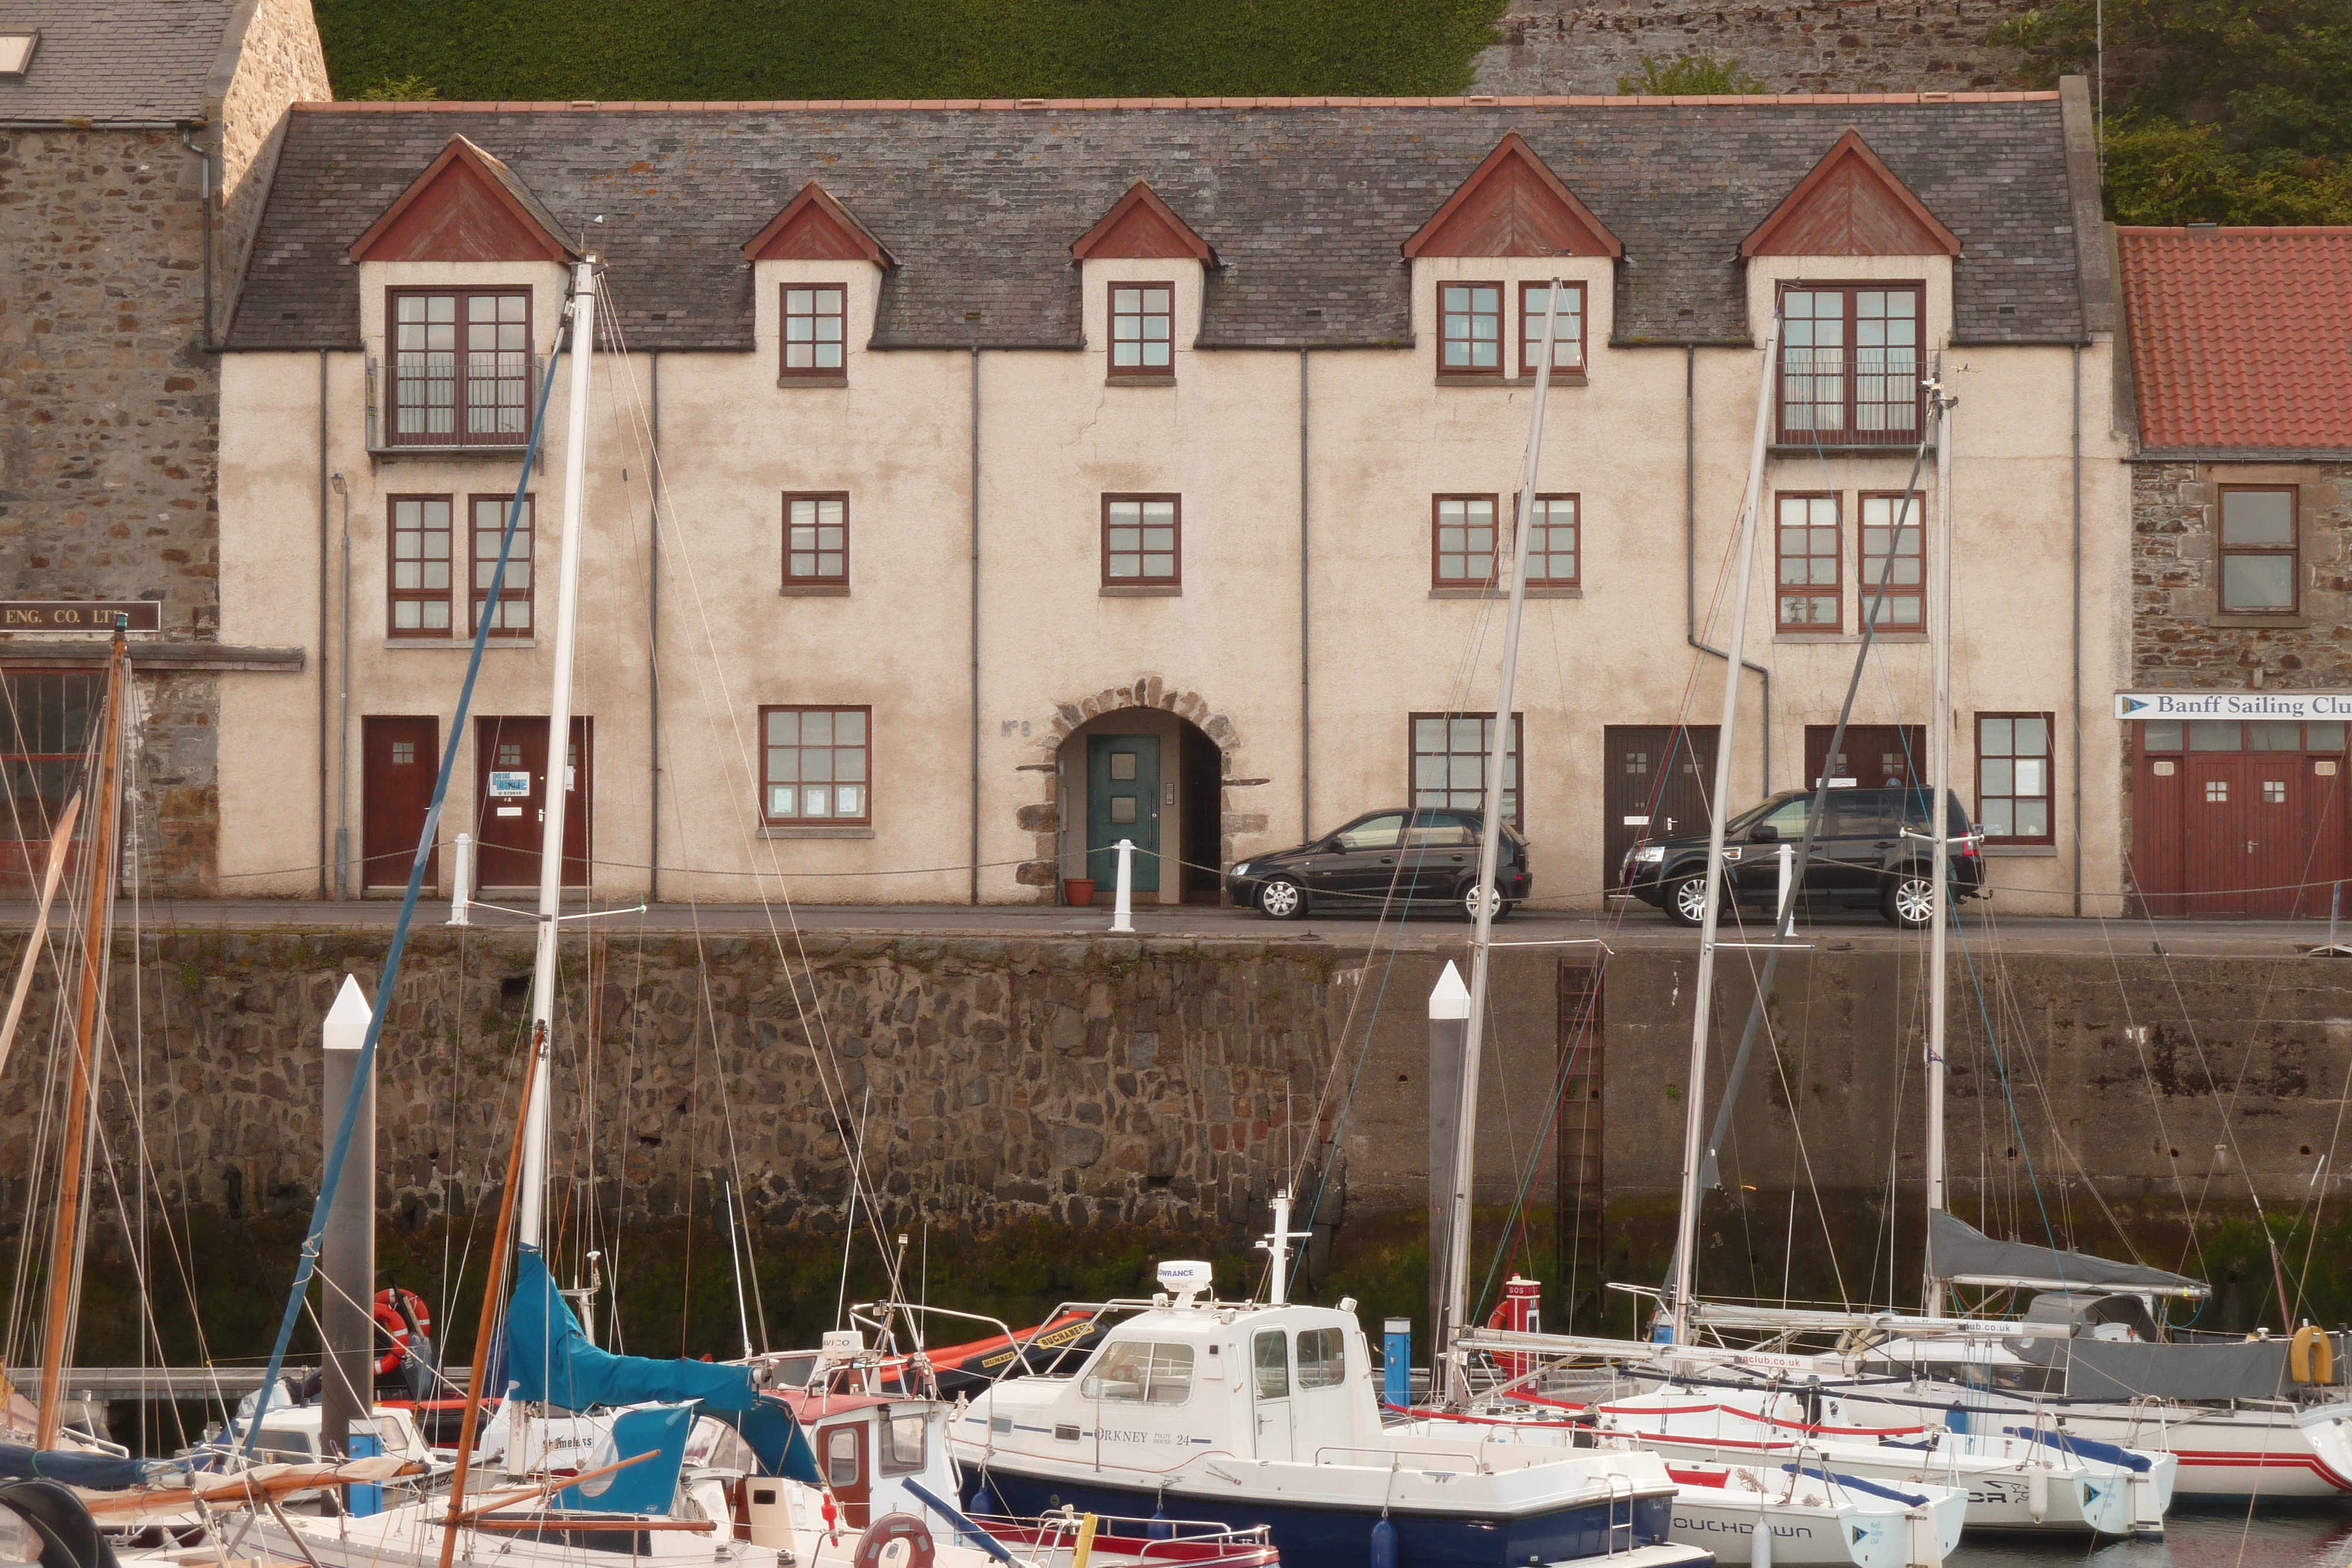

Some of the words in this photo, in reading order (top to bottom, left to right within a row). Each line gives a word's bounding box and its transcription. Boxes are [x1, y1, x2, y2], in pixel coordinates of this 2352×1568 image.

[5, 609, 42, 623] ENG.
[53, 609, 81, 623] CO.
[2157, 696, 2221, 713] Banff
[2228, 696, 2304, 718] Sailing
[1021, 720, 1031, 737] 8
[984, 1353, 1014, 1366] HUMBER
[1094, 1427, 1148, 1443] ORKNEY
[1177, 1435, 1190, 1446] 24
